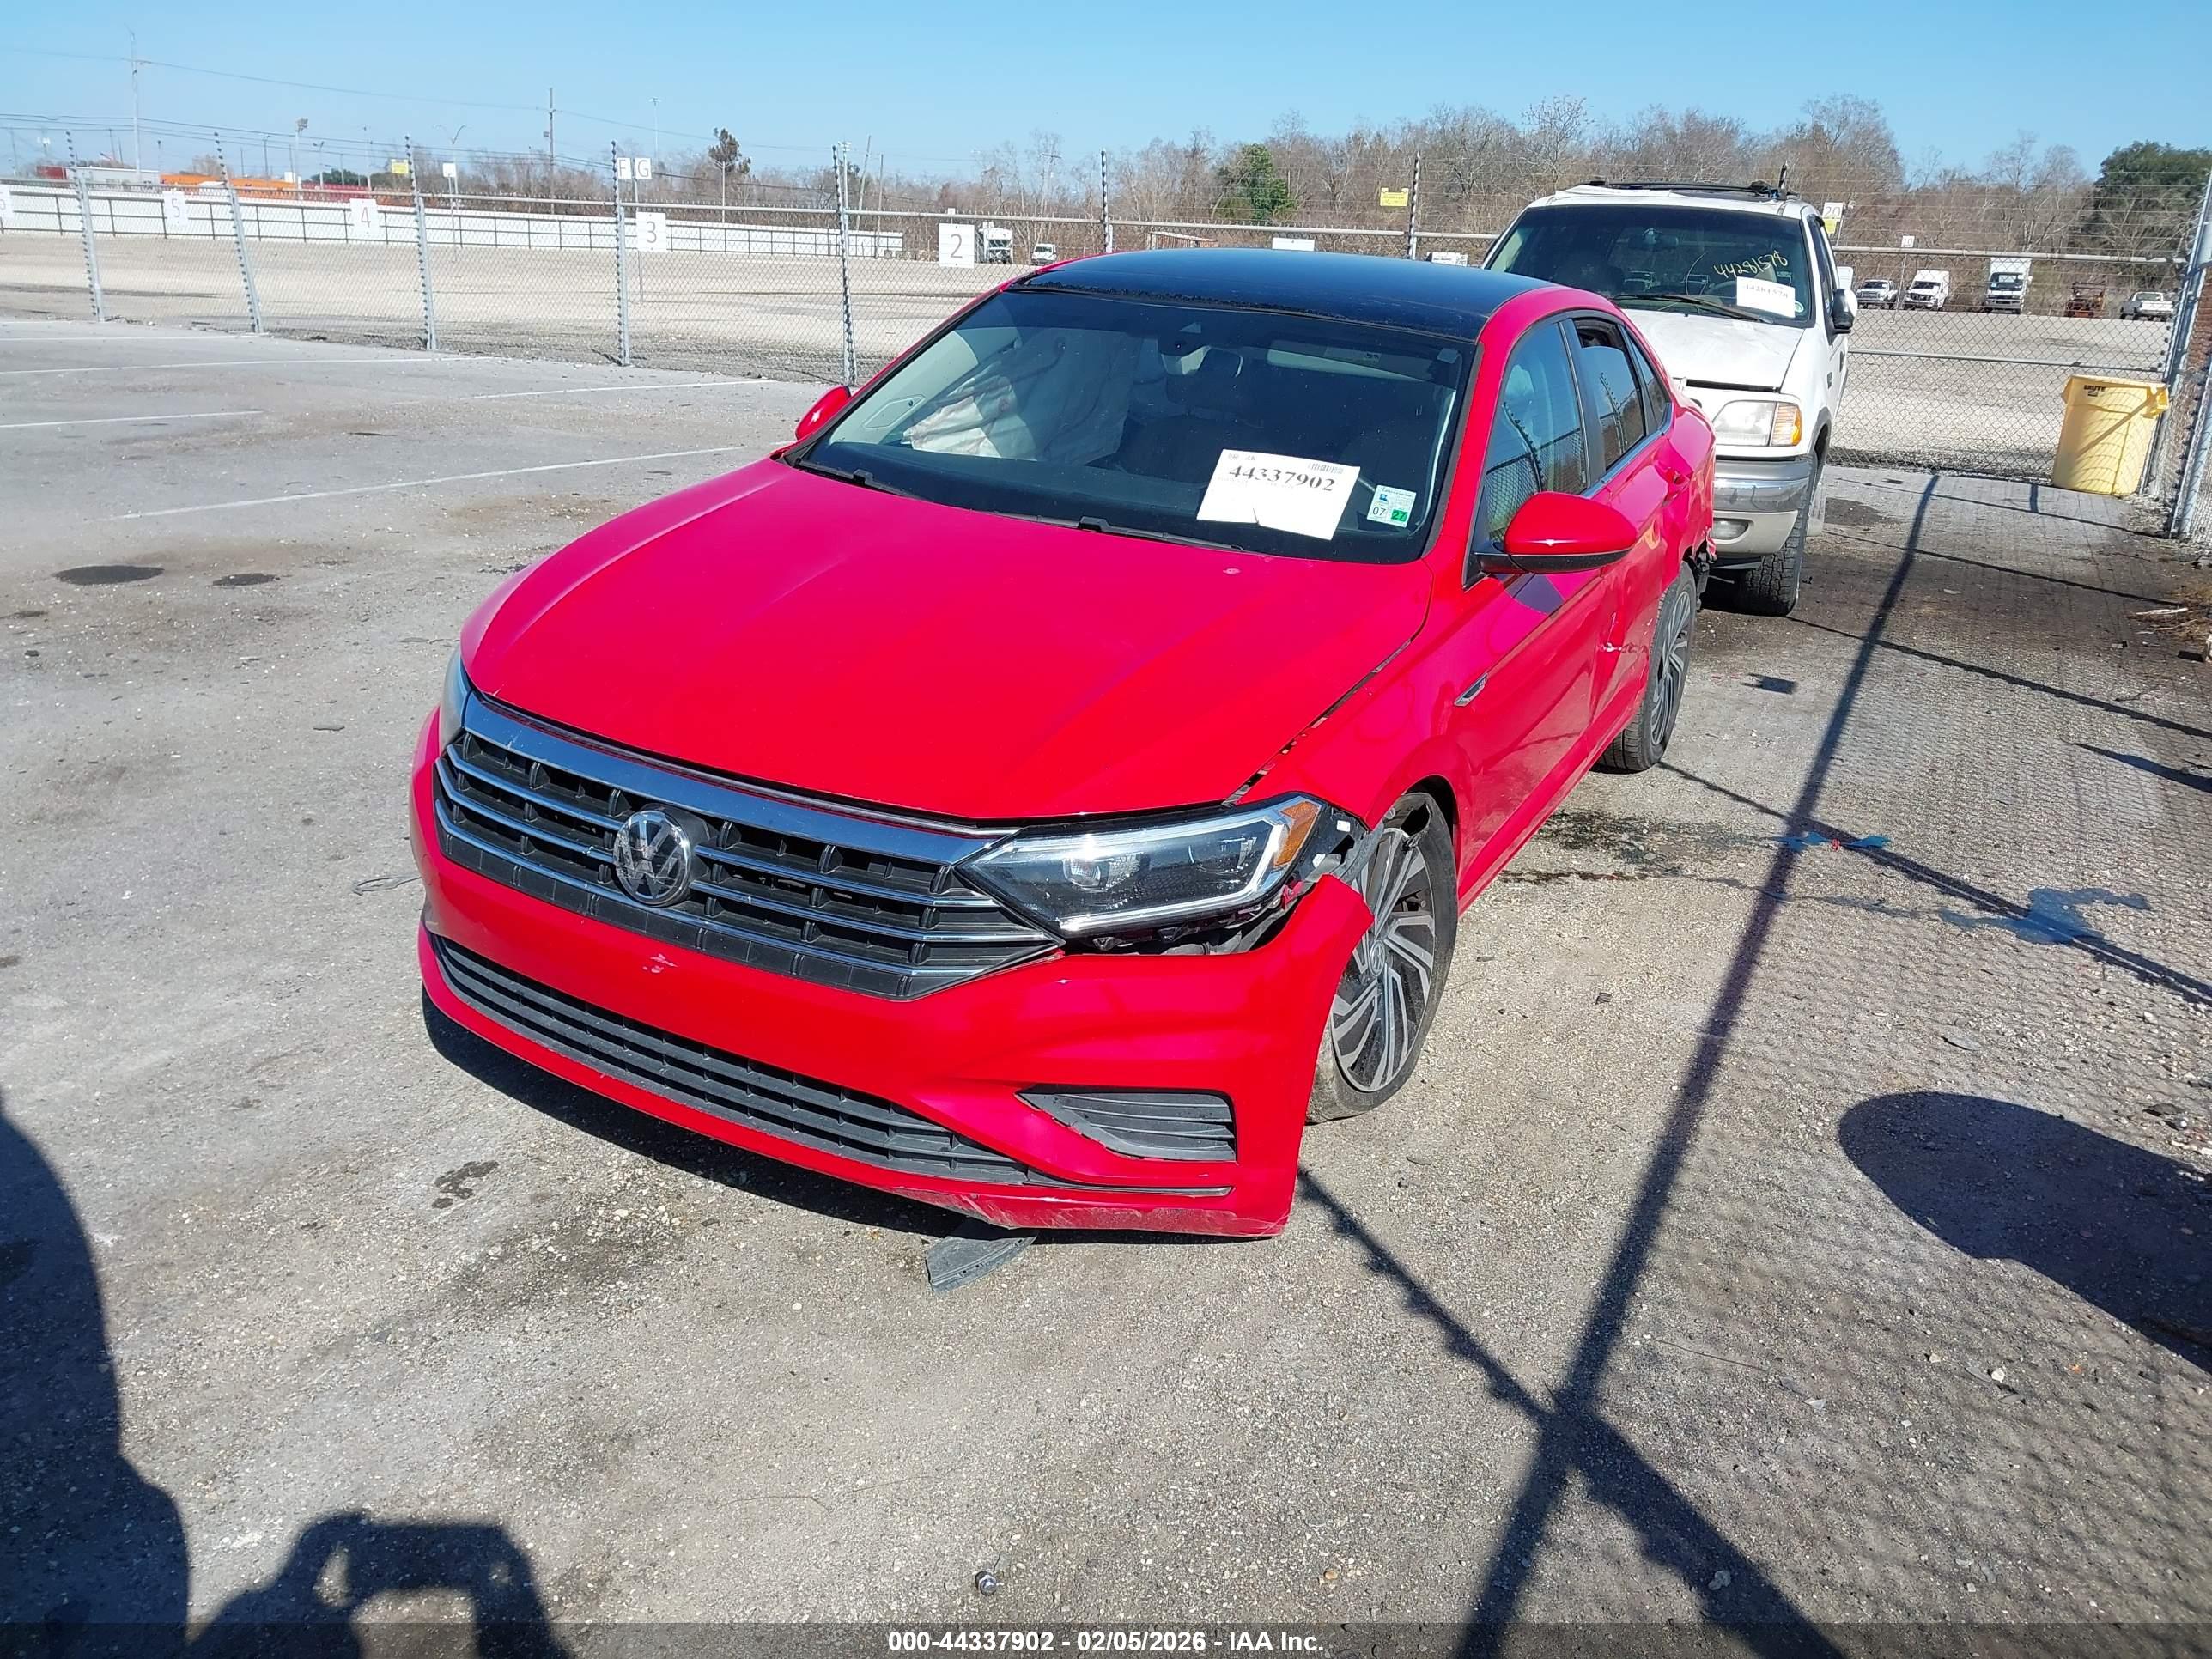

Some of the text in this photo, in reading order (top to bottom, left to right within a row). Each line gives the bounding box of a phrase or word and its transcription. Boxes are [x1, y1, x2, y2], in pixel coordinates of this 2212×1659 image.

[618, 159, 627, 178] F
[637, 159, 649, 178] G
[171, 198, 180, 218] 5
[361, 206, 371, 228] 4
[1823, 205, 1841, 218] 20
[646, 221, 657, 244] 3
[950, 233, 963, 259] 2
[1714, 250, 1788, 279] 44281578
[1229, 465, 1336, 492] 44337902
[1372, 507, 1387, 516] 07
[1390, 509, 1408, 522] 27
